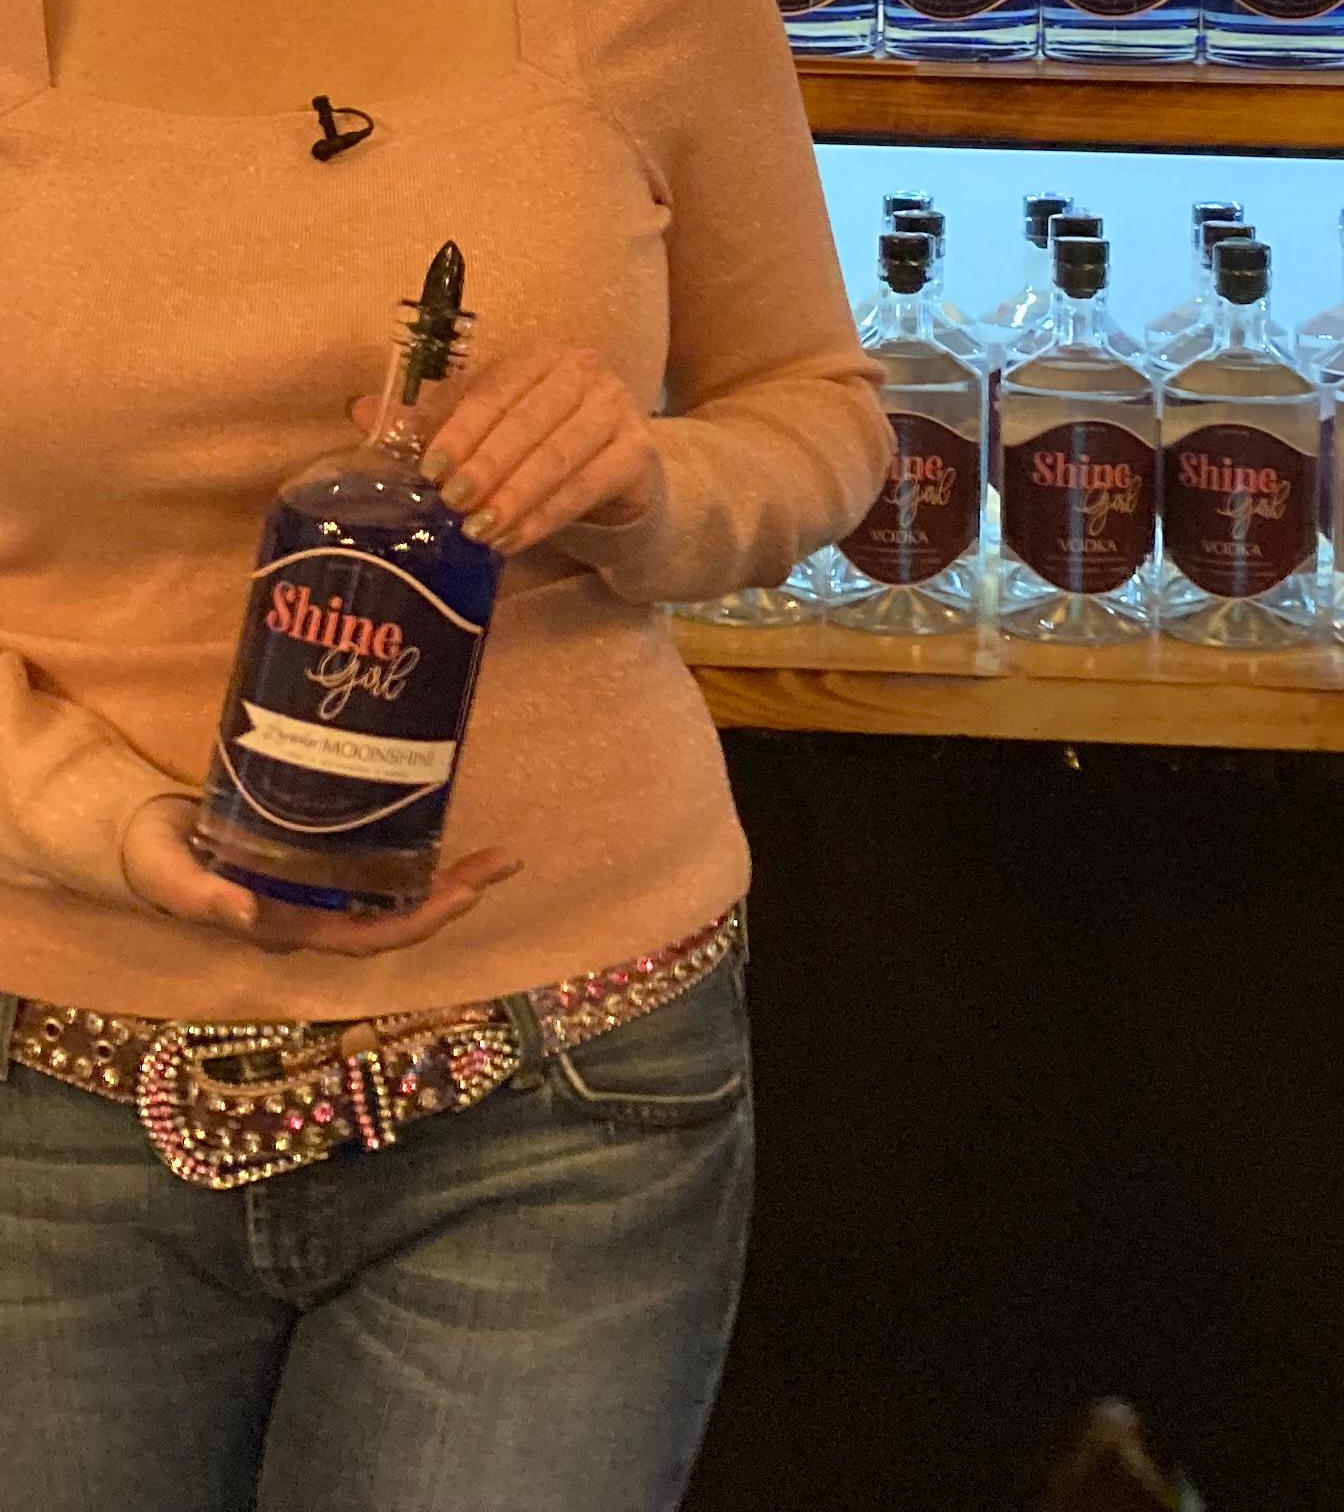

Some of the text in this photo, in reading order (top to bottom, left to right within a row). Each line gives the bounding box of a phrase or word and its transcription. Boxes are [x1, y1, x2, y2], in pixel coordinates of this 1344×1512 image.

[1032, 452, 1132, 489] Shine
[1179, 454, 1278, 493] Shine
[265, 581, 403, 660] Shine
